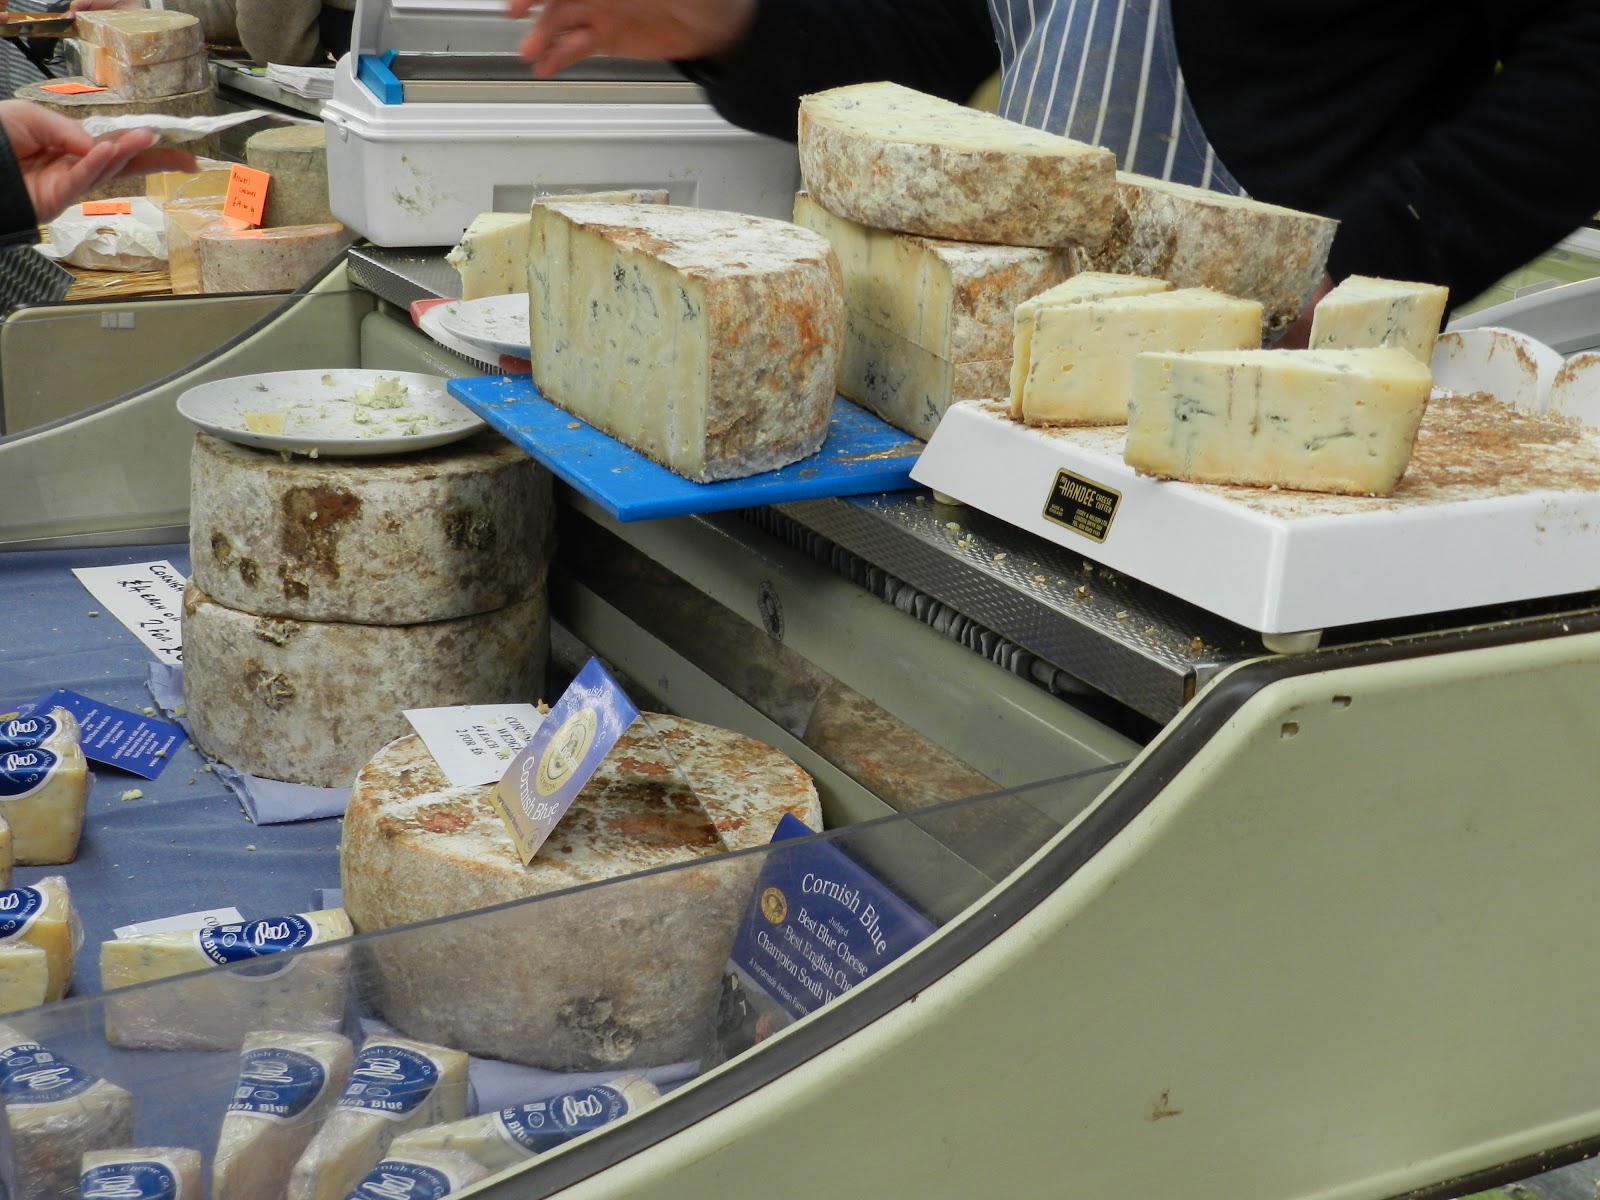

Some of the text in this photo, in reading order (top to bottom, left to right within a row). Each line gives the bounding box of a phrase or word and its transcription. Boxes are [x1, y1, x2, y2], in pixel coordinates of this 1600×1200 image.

[1059, 480, 1097, 507] HANDEE
[1096, 494, 1113, 506] CHEESE
[1096, 502, 1113, 514] CUTTER
[519, 755, 538, 818] Cornish
[530, 801, 560, 821] Blue
[802, 873, 888, 955] Cornish Blue
[828, 916, 850, 937] Judged
[203, 939, 228, 965] Blue
[797, 907, 868, 978] Best Blue Cheese
[757, 930, 824, 1000] Champion South
[784, 924, 854, 992] Best English Che
[369, 1100, 404, 1111] Blue
[506, 1120, 536, 1147] Blue
